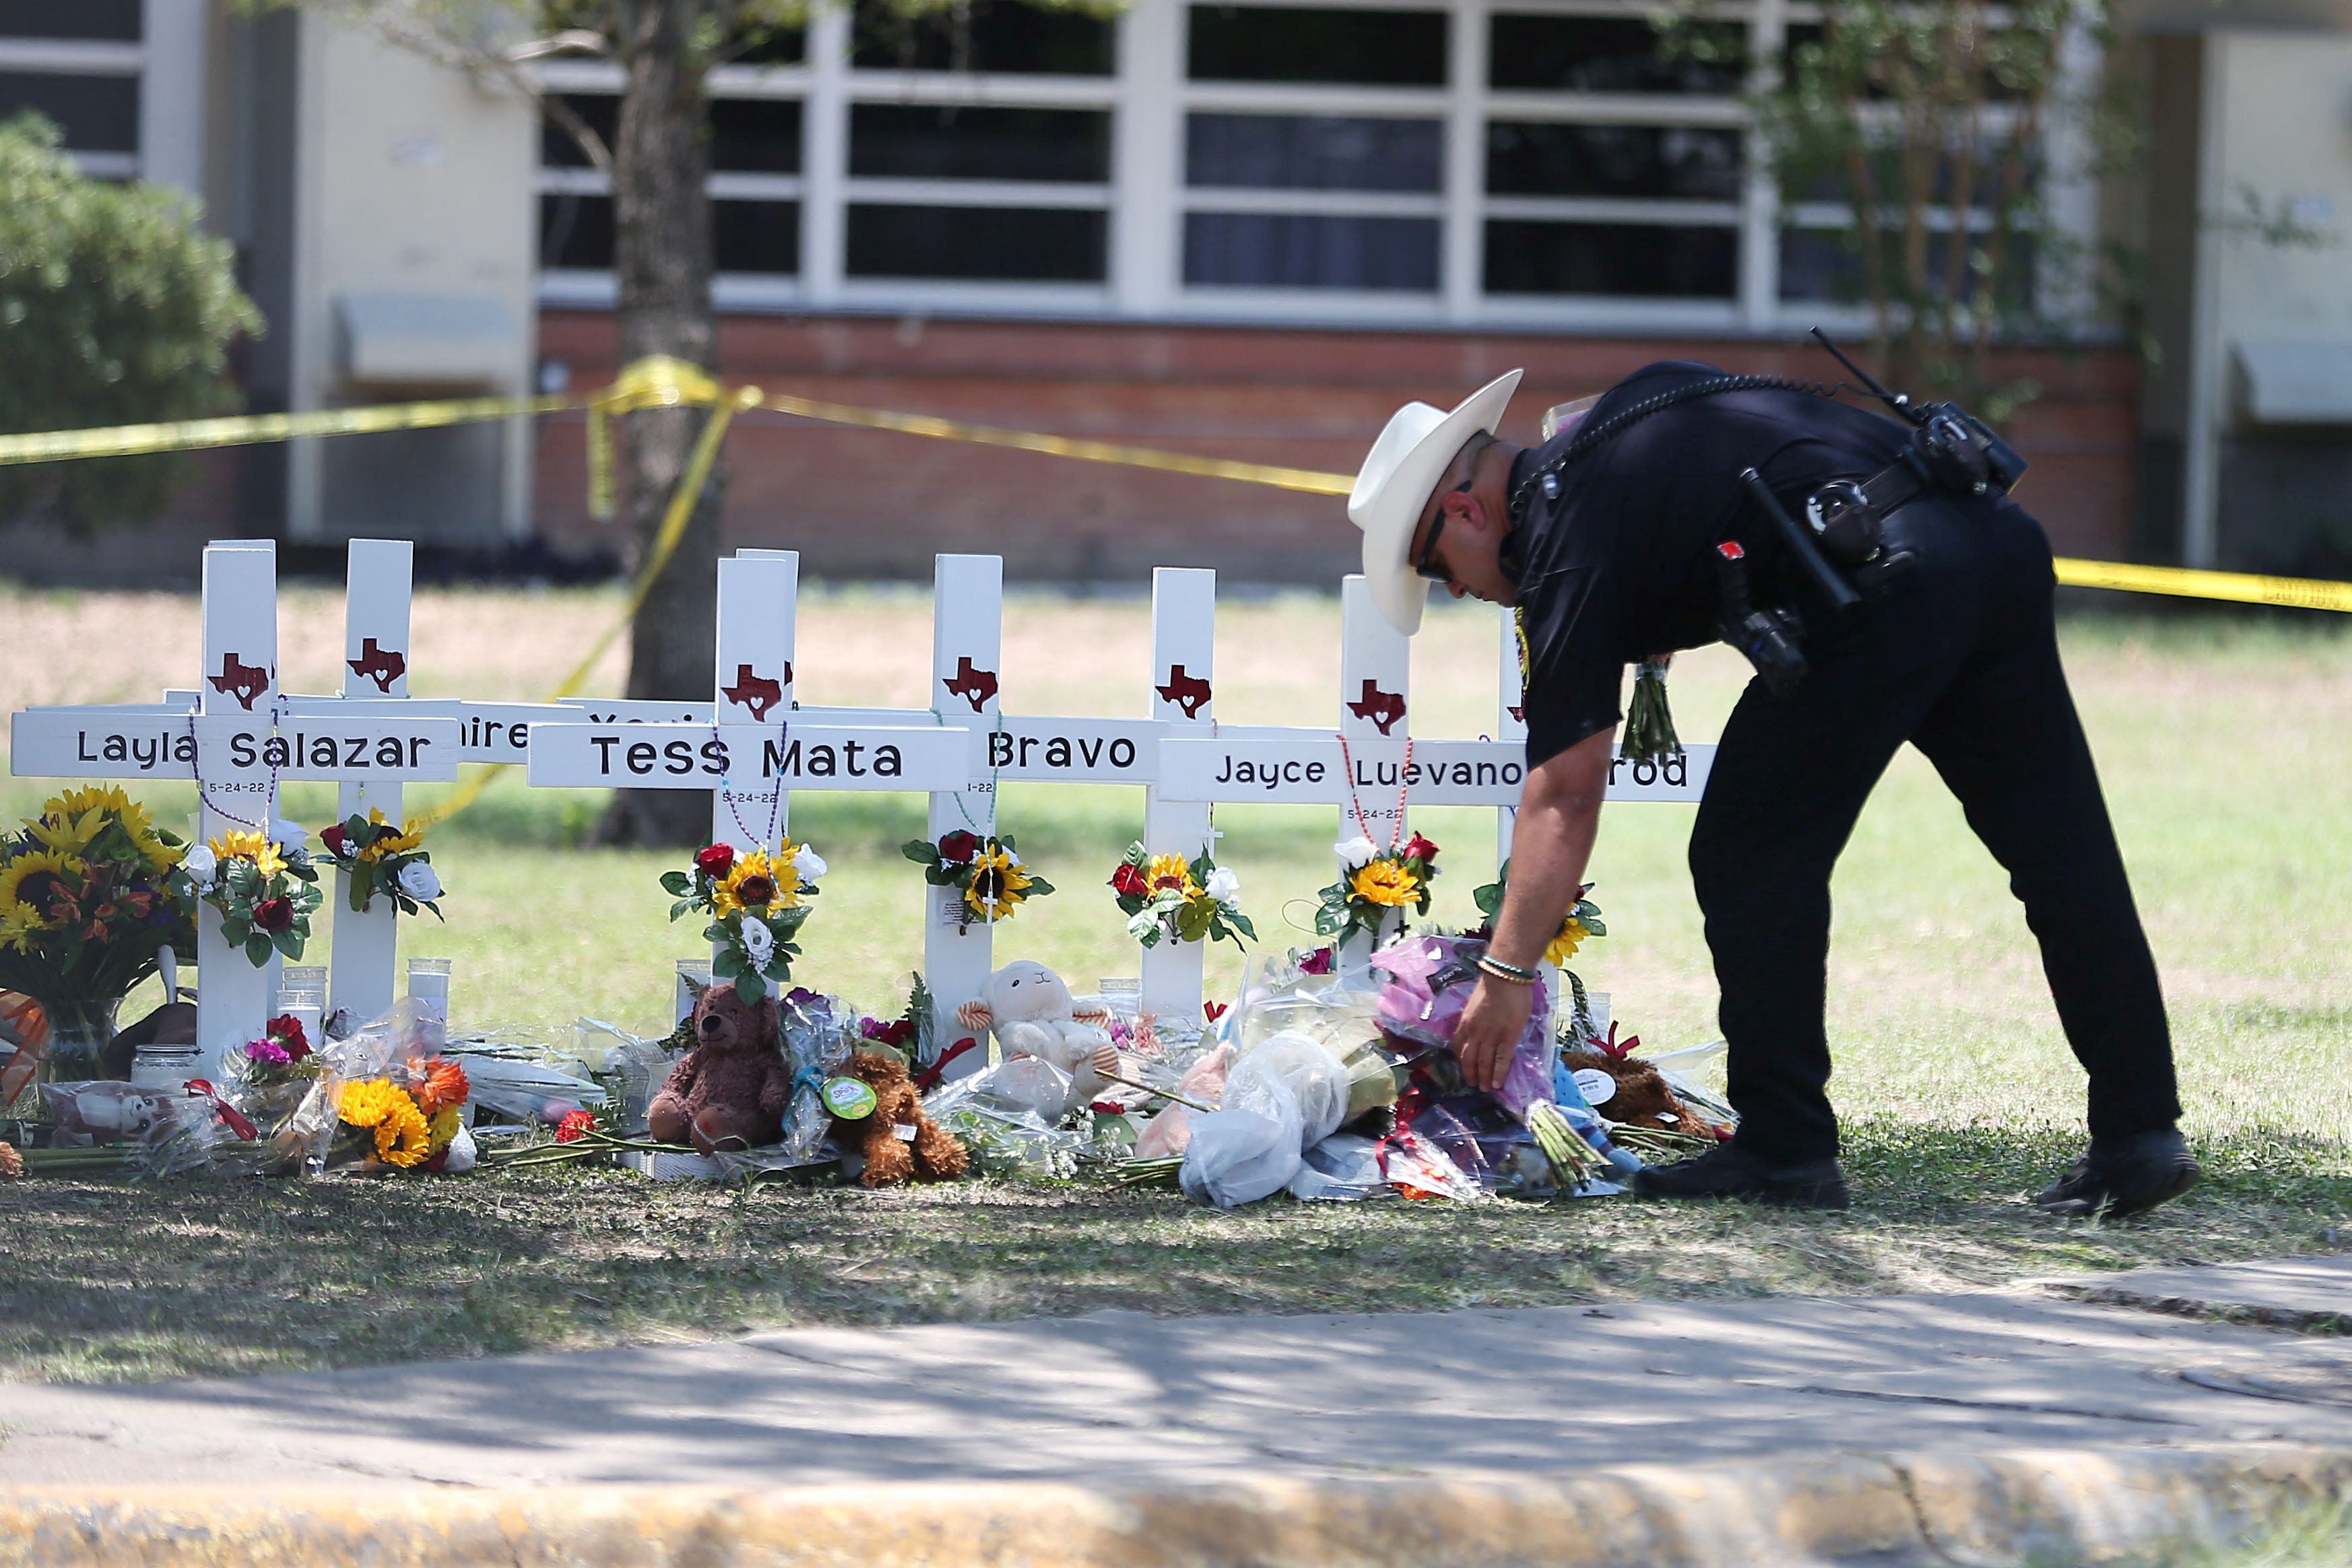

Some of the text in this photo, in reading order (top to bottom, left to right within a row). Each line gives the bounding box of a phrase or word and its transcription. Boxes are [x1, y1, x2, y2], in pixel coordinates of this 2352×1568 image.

[461, 716, 528, 748] ire
[988, 731, 1136, 768] Bravo
[79, 731, 431, 770] Layla Salazar
[591, 737, 903, 778] Tess Mata
[209, 783, 265, 792] 5-24-22
[1215, 756, 1326, 789] Jayce
